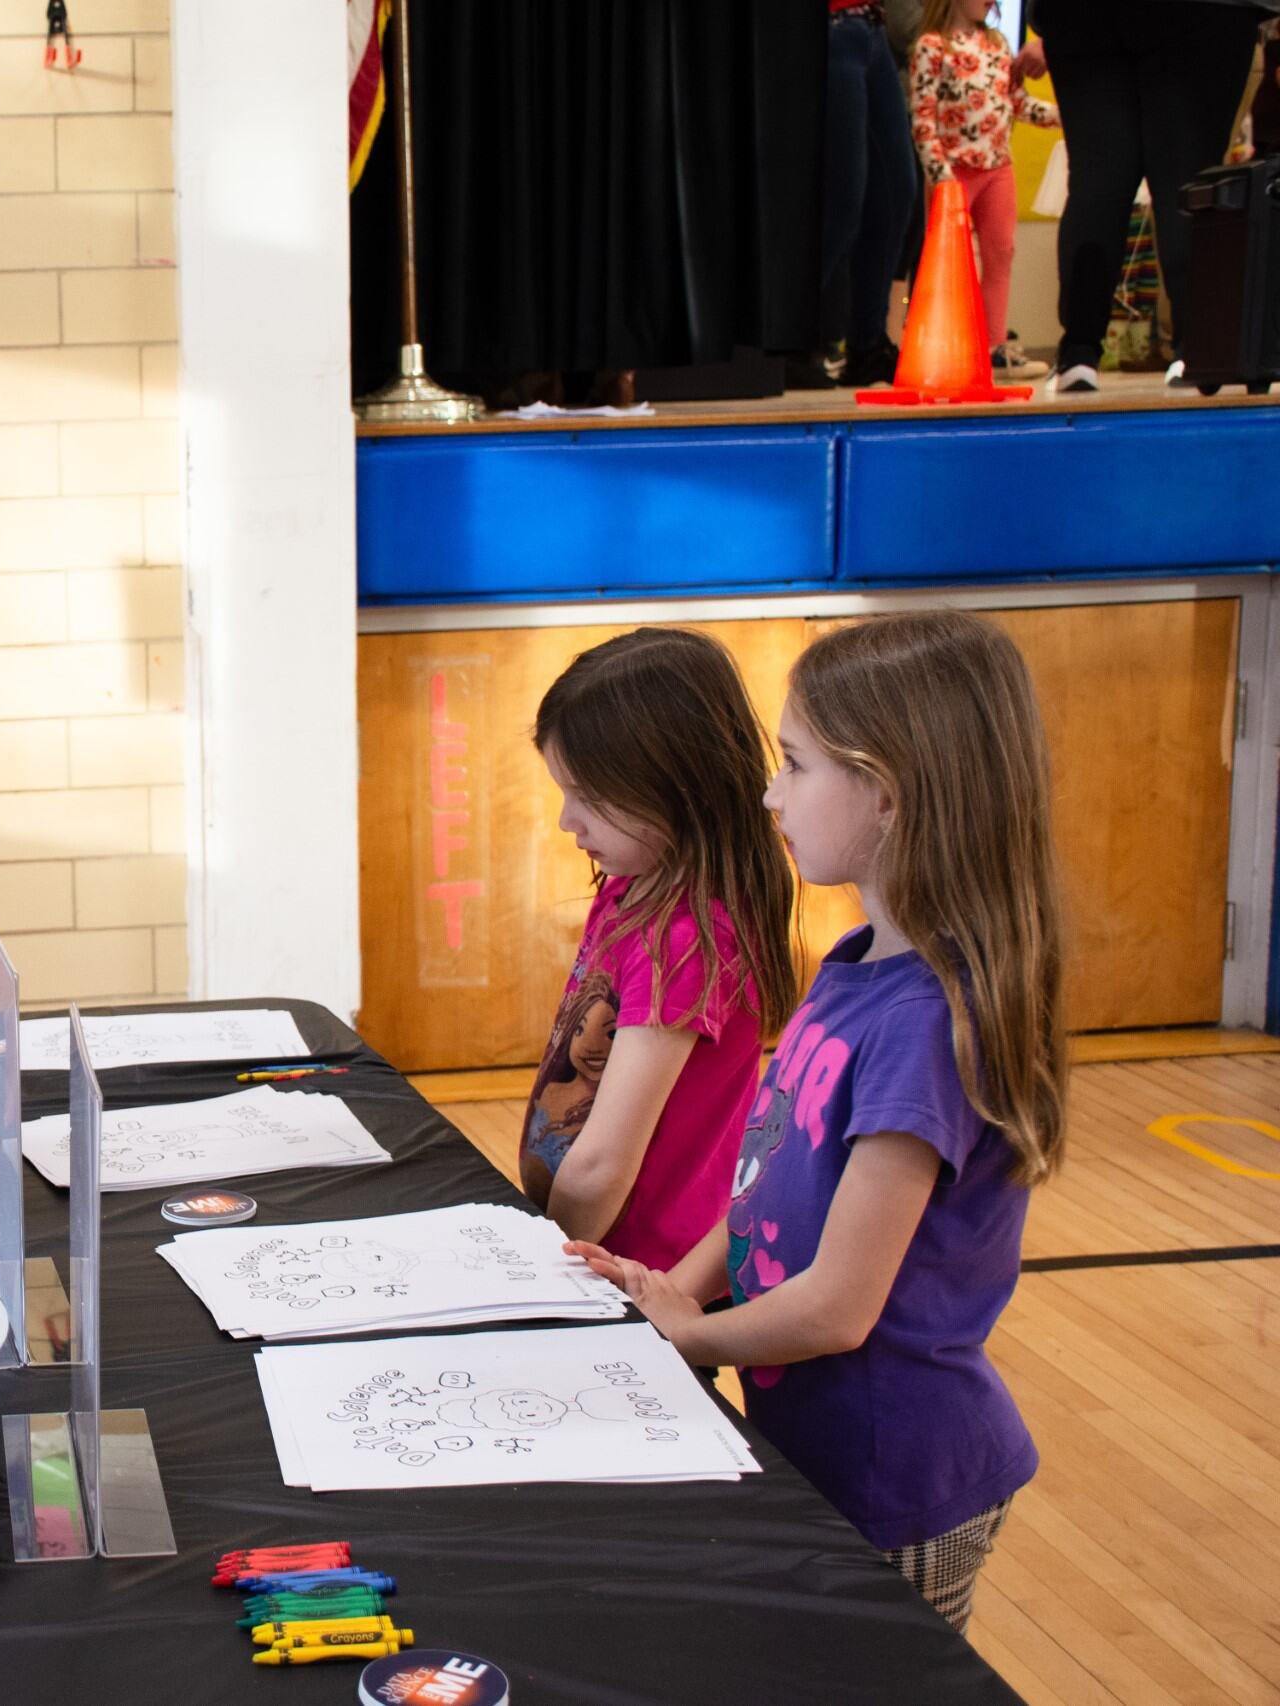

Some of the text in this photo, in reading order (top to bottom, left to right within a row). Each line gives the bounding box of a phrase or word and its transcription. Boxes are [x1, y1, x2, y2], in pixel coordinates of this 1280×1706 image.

[425, 672, 485, 949] LEFT
[166, 1196, 220, 1213] ME
[223, 1238, 288, 1280] Science
[592, 1360, 647, 1387] ME
[326, 1368, 436, 1468] Data Science
[330, 1631, 375, 1645] Crayons
[377, 1671, 414, 1696] DATA
[386, 1666, 434, 1705] SCIENCE
[429, 1656, 489, 1703] ME
